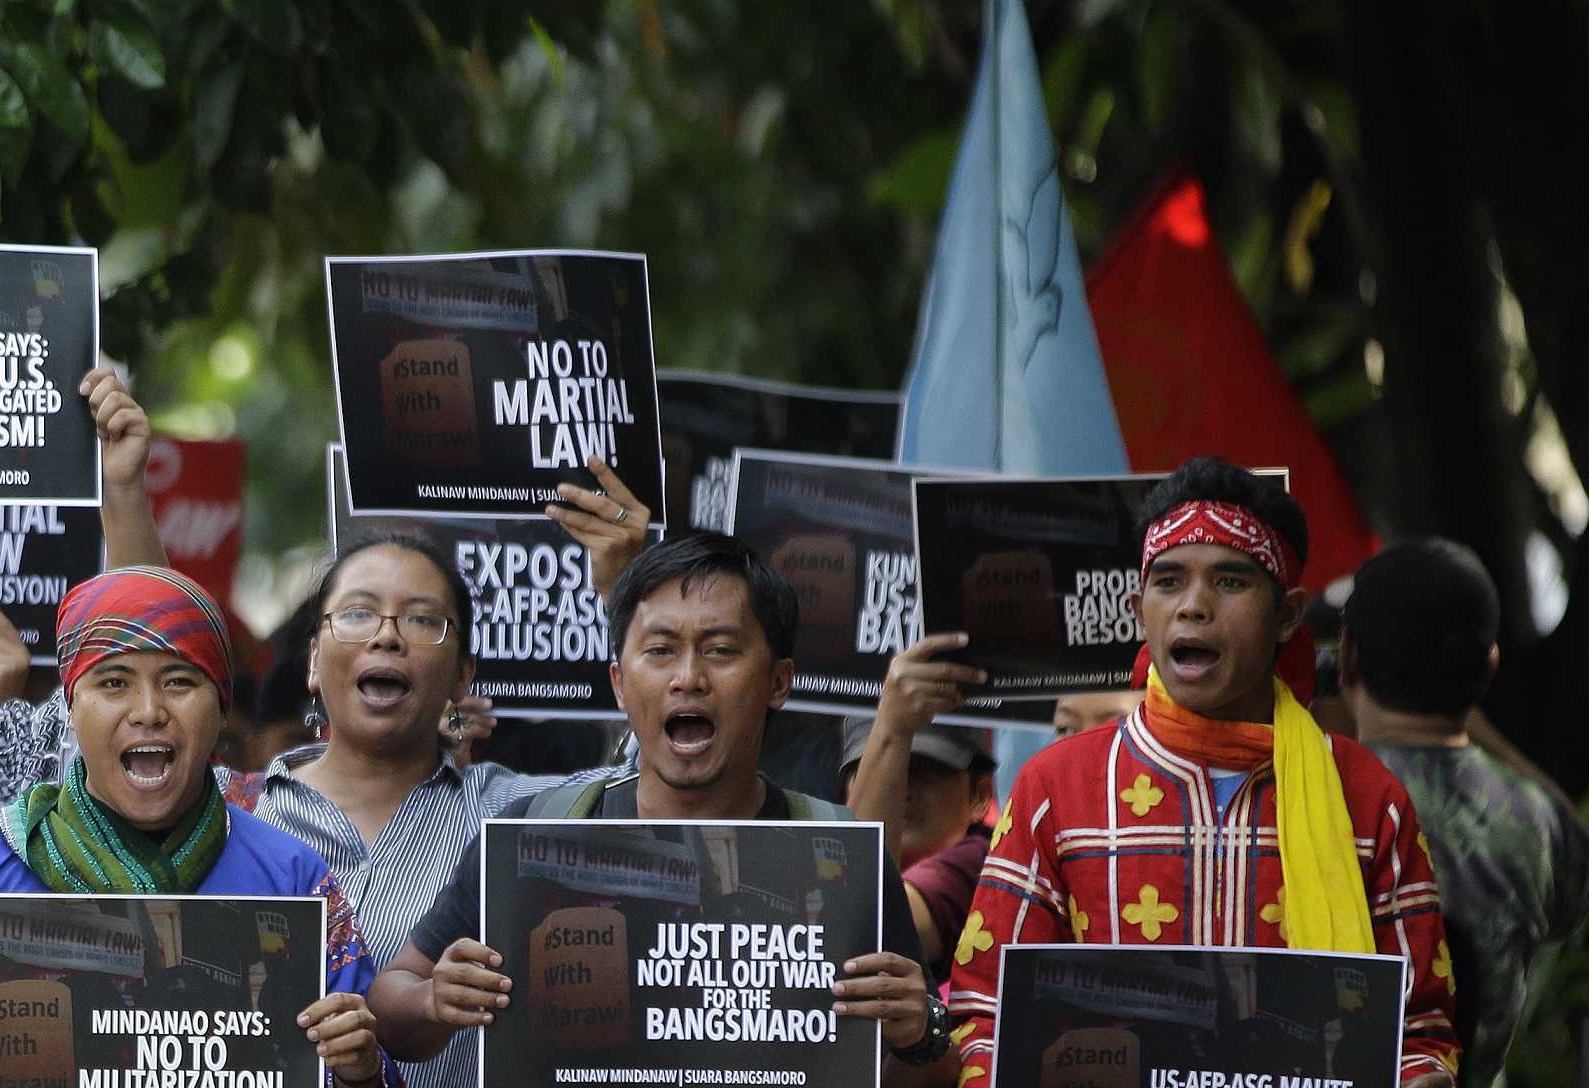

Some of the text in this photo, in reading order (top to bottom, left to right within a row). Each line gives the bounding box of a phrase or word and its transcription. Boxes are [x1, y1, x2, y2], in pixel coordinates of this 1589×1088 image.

[527, 340, 608, 379] NO TO
[493, 377, 634, 425] MARTIAL
[531, 423, 618, 468] LAW!
[418, 484, 528, 501] KALINAW MINDANAW
[457, 543, 594, 591] EXPOS
[481, 683, 592, 698] SUARA BANGSAMORO
[648, 923, 825, 961] JUST PEACE
[637, 959, 836, 989] NOT ALL OUT WAR
[703, 988, 771, 1010] FOR THE
[92, 1009, 271, 1037] MINDANAO SAYS:
[646, 1008, 837, 1043] BANGSMARO!
[137, 1036, 227, 1071] NO TO
[555, 1068, 806, 1086] KALINAW MINDANAW SUARA BANGSAMORO
